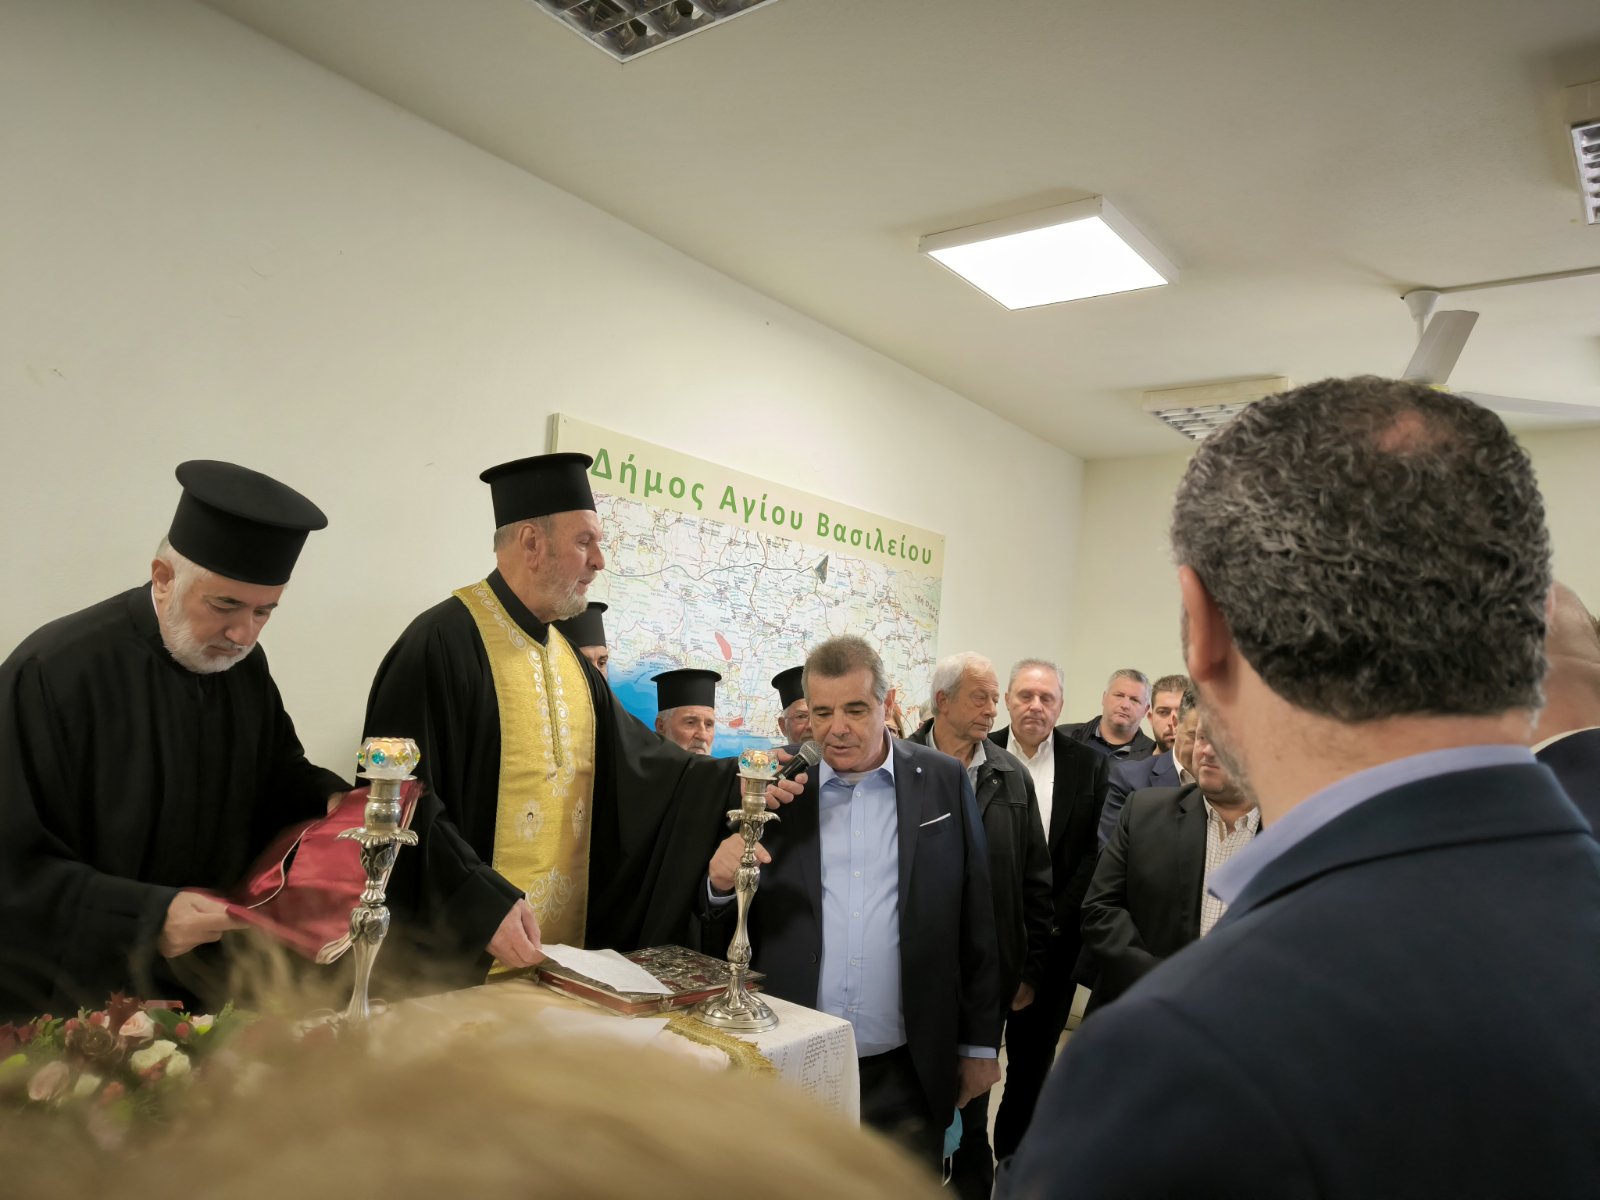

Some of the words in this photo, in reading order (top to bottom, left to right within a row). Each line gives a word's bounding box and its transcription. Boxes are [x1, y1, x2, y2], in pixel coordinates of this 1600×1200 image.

[590, 448, 705, 511] Δήμος
[719, 486, 804, 530] Αγίου
[817, 512, 932, 565] Βασιλείου
